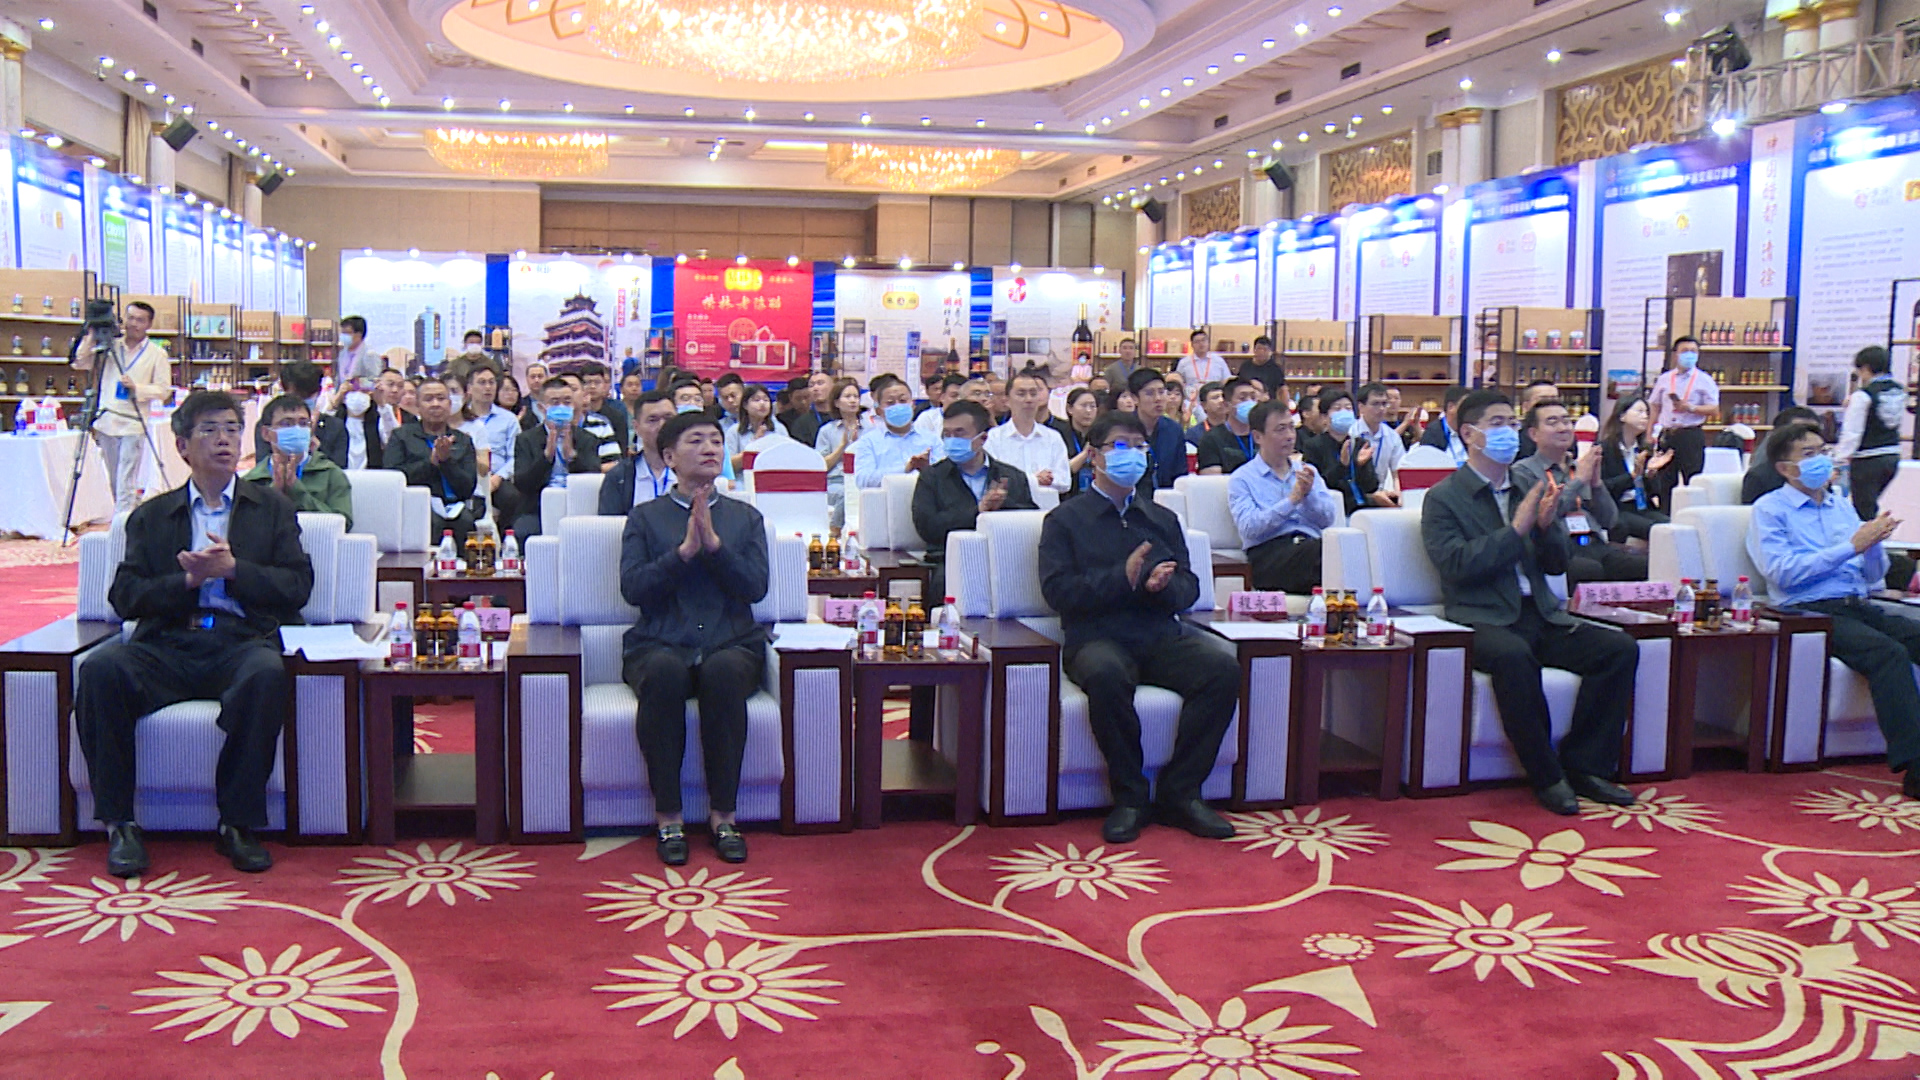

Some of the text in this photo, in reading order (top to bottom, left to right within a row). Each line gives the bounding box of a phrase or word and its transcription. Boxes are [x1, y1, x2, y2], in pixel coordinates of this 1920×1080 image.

[1759, 134, 1779, 288] 中国醋都·清徐
